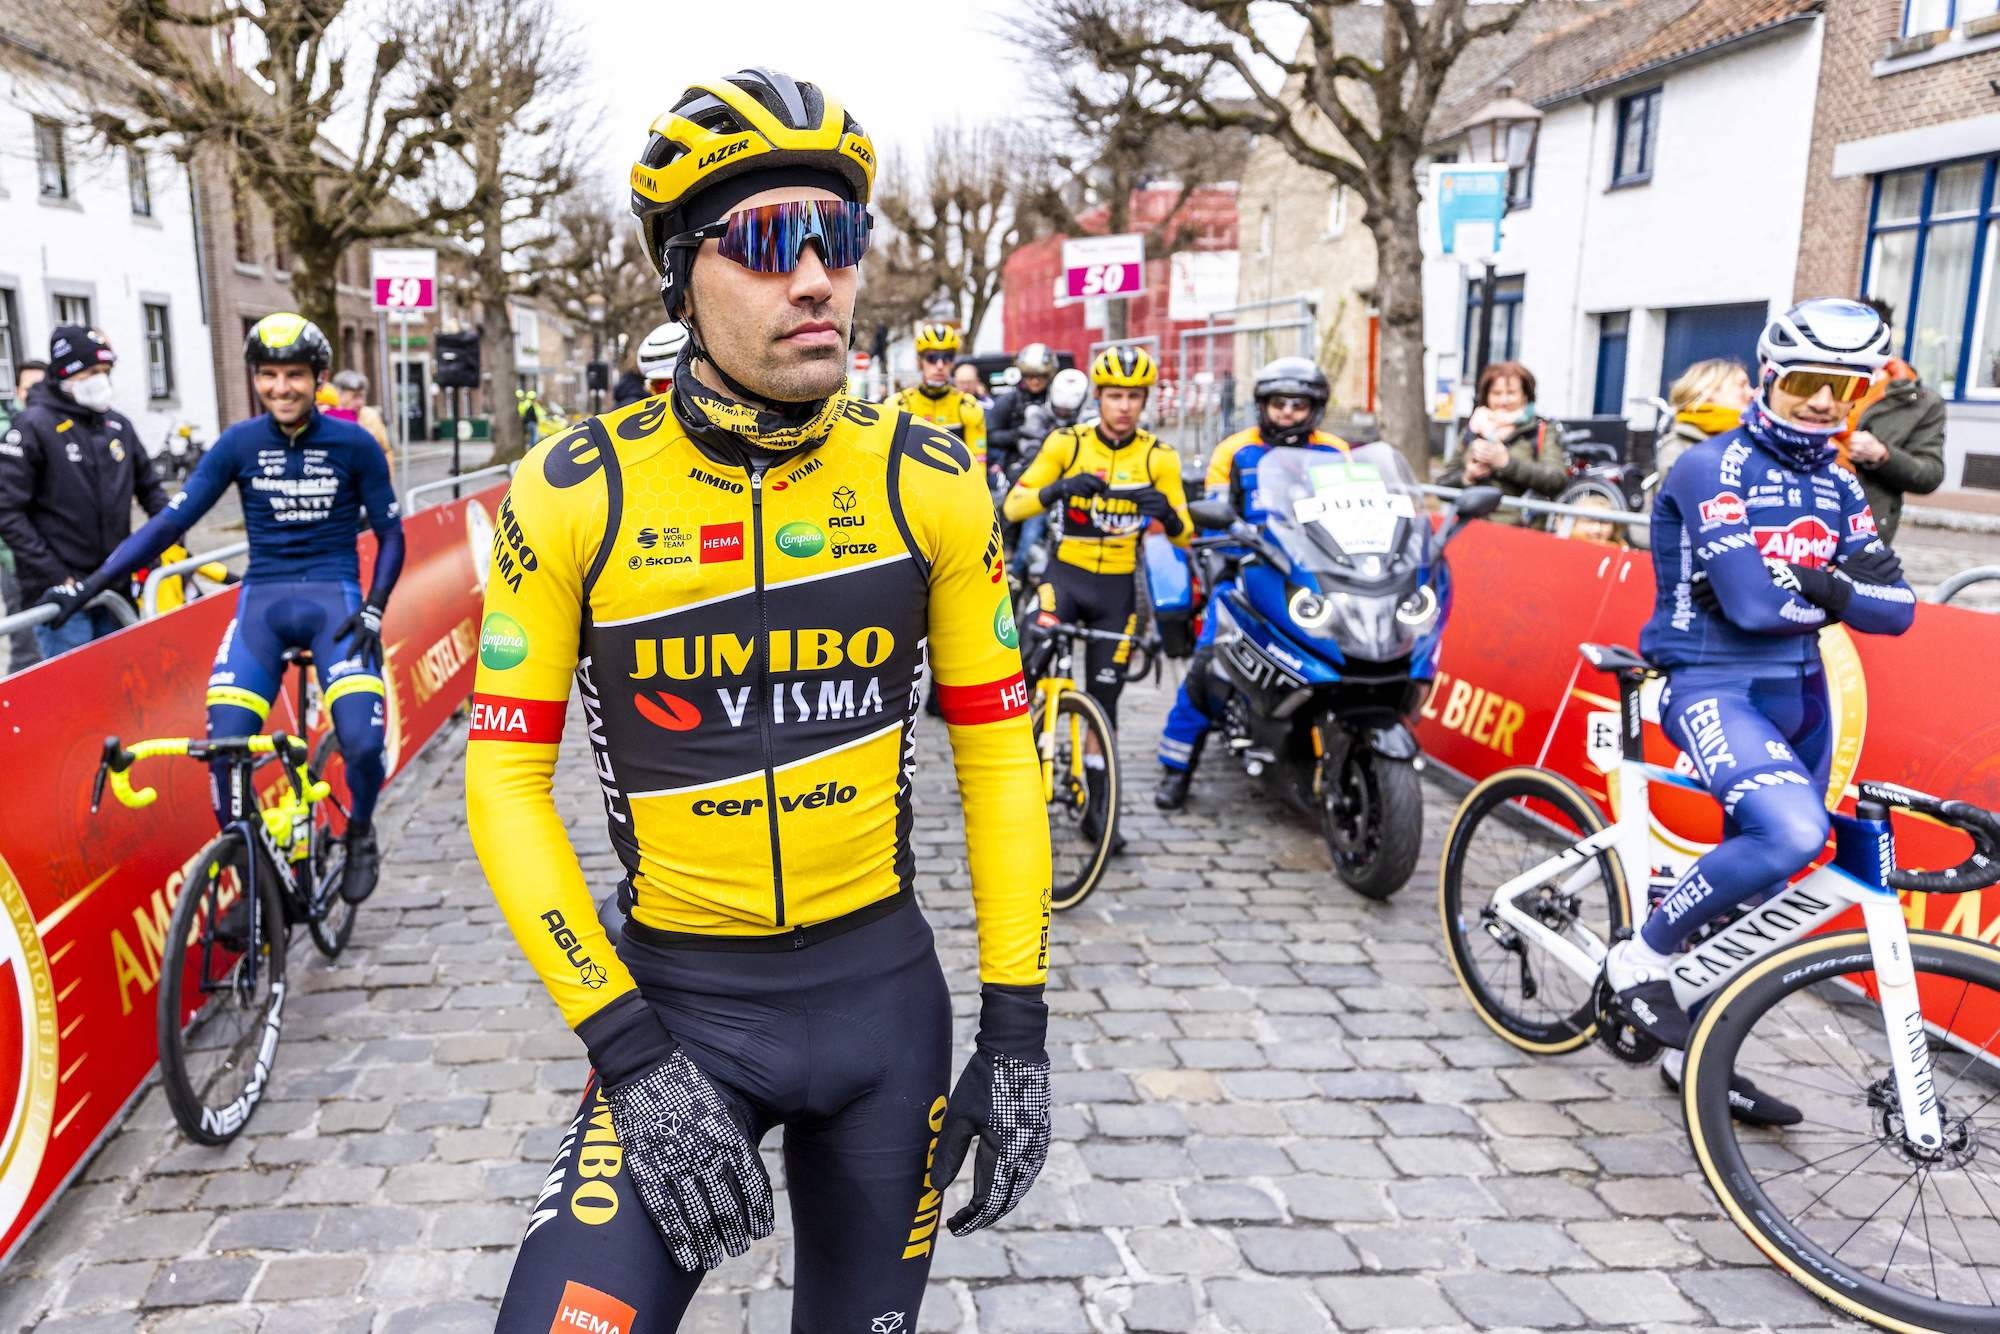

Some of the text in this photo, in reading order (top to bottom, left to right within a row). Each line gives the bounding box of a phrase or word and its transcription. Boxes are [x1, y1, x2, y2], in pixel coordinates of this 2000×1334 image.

[698, 138, 749, 170] LAZER
[386, 277, 421, 306] 50
[1081, 263, 1124, 295] 50
[688, 467, 744, 495] JUMBO
[787, 457, 823, 484] VISMA
[663, 527, 680, 535] UCI
[663, 533, 693, 541] WORLD
[828, 515, 865, 528] AGU
[703, 536, 740, 550] HEMA
[779, 530, 823, 550] Campina
[831, 542, 877, 559] graze
[645, 556, 693, 566] ŠKODA
[480, 628, 525, 653] Campina
[629, 626, 895, 681] JUMBO
[716, 677, 884, 728] VISMA
[1000, 680, 1028, 711] HE
[1441, 678, 1525, 758] BIER
[575, 655, 627, 824] HEMA
[1594, 722, 1613, 748] 44
[1686, 698, 1735, 776] FENIX
[691, 781, 858, 816] cervélo
[1662, 874, 1713, 926] FENIX
[540, 909, 592, 968] AGU
[1675, 890, 1832, 988] CANYON
[1782, 953, 1873, 984] DURA-AC
[1904, 1010, 1938, 1116] CANYON
[570, 1086, 624, 1226] MBO
